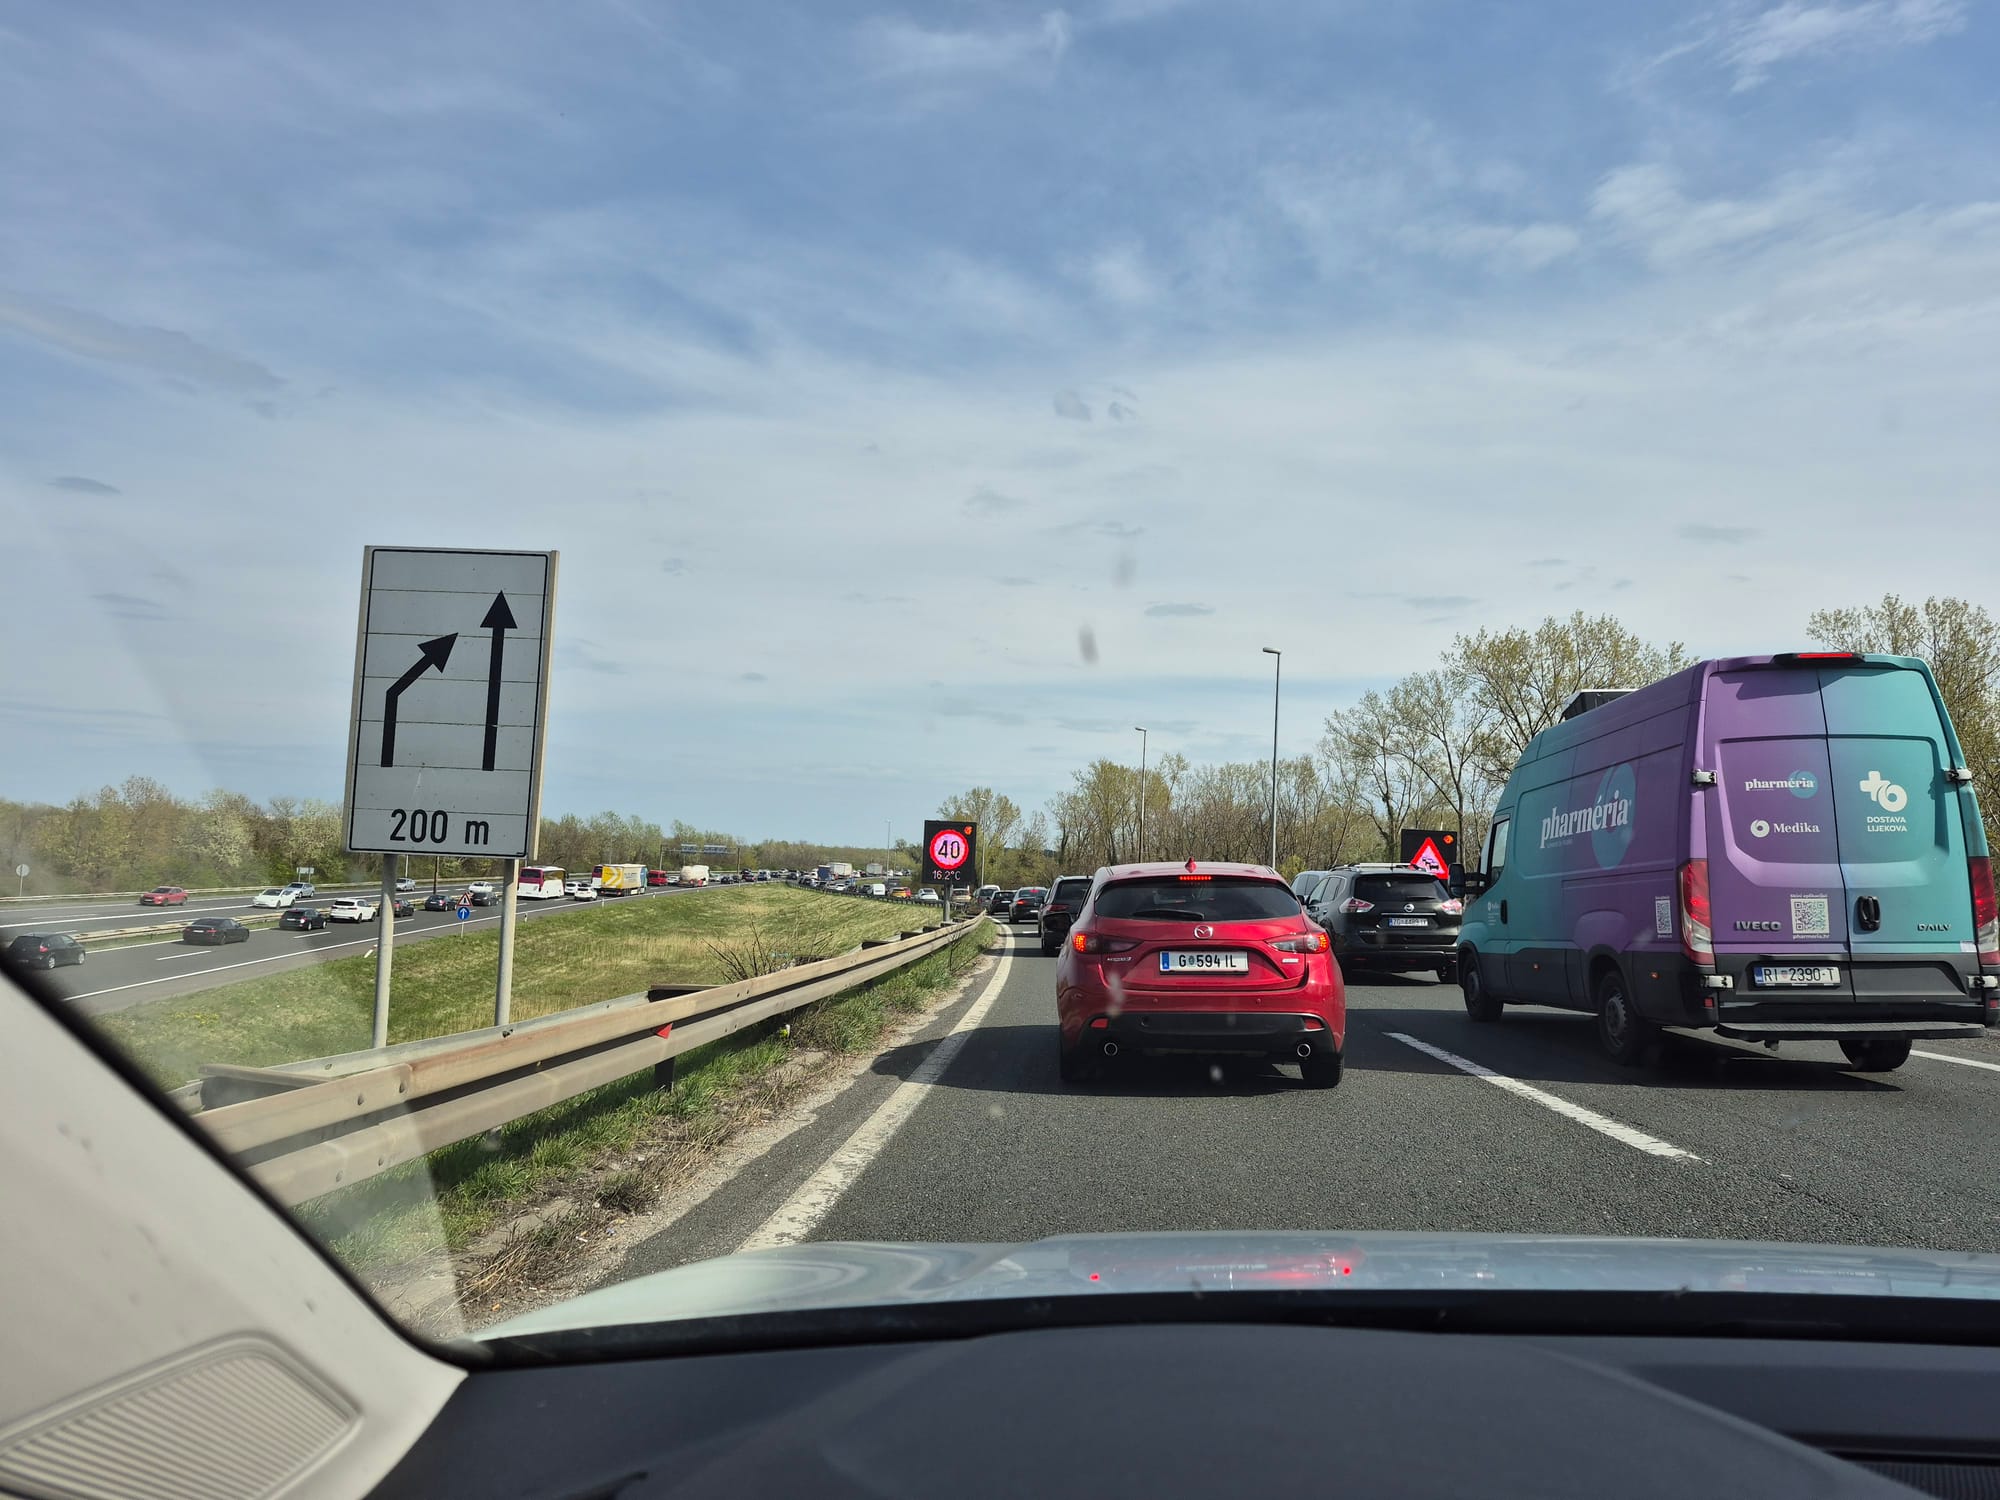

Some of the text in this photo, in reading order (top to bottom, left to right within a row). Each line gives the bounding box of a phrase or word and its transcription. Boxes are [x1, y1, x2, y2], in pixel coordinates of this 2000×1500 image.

[1540, 789, 1629, 849] pharméria
[1866, 815, 1907, 824] DOSTAVA
[389, 808, 490, 845] 200 m
[1773, 821, 1821, 833] Medika
[1867, 824, 1908, 833] LIJEKOVA
[937, 839, 961, 859] 40
[932, 870, 961, 881] 16.2°C
[1735, 920, 1782, 932] IVECO
[1917, 923, 1952, 932] DAILY
[1178, 954, 1237, 968] G 594 IL
[1763, 967, 1835, 982] RI 2390-T
